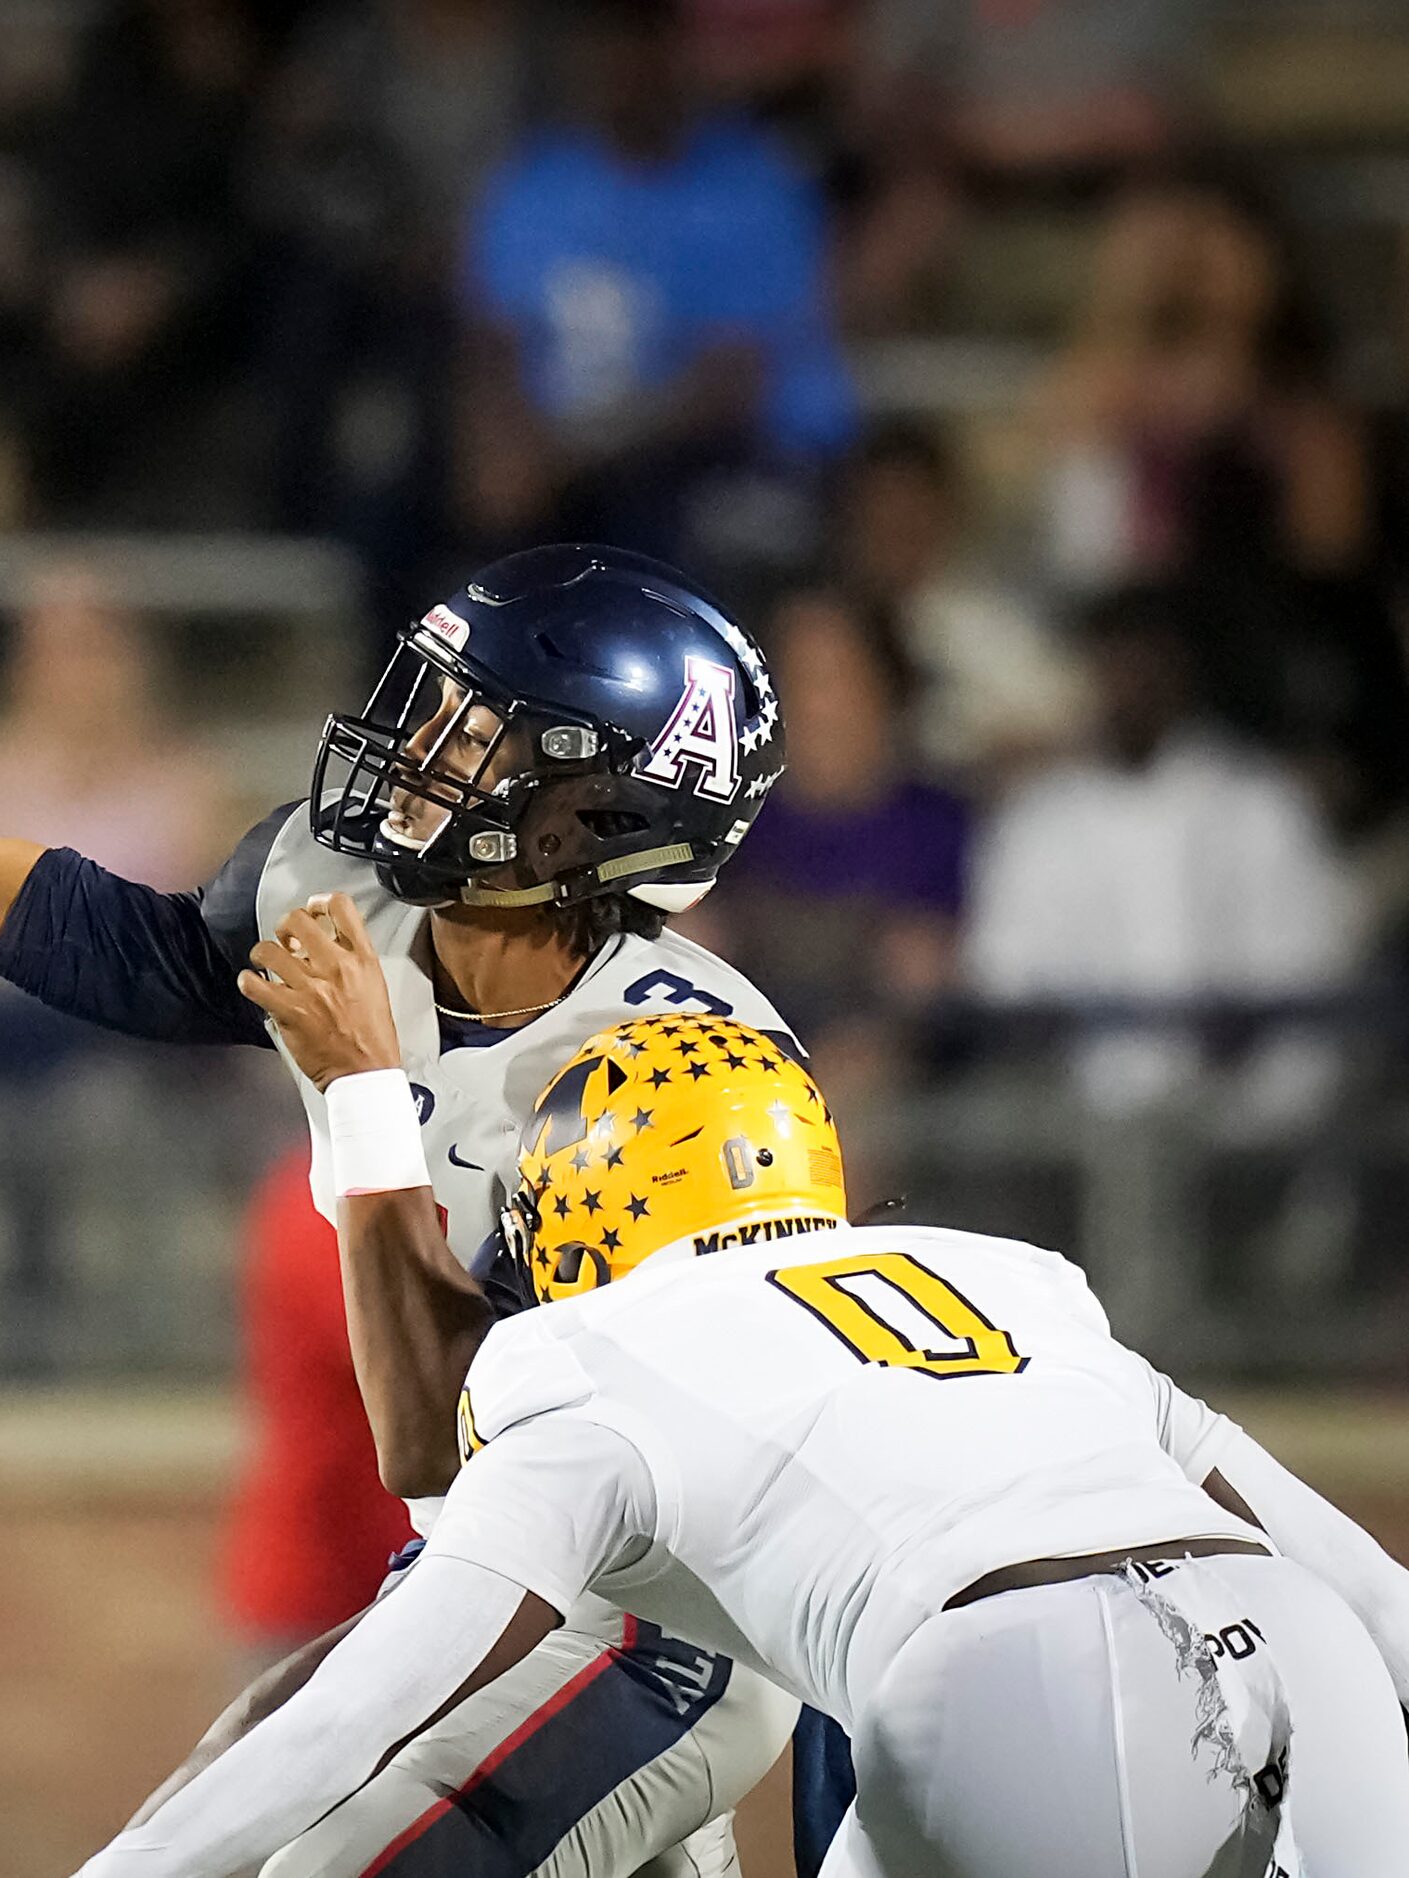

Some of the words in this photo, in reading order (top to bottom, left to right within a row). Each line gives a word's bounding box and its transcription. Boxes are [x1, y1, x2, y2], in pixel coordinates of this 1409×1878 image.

[631, 655, 742, 805] A
[722, 1136, 755, 1190] 0
[764, 1252, 1032, 1380] 0
